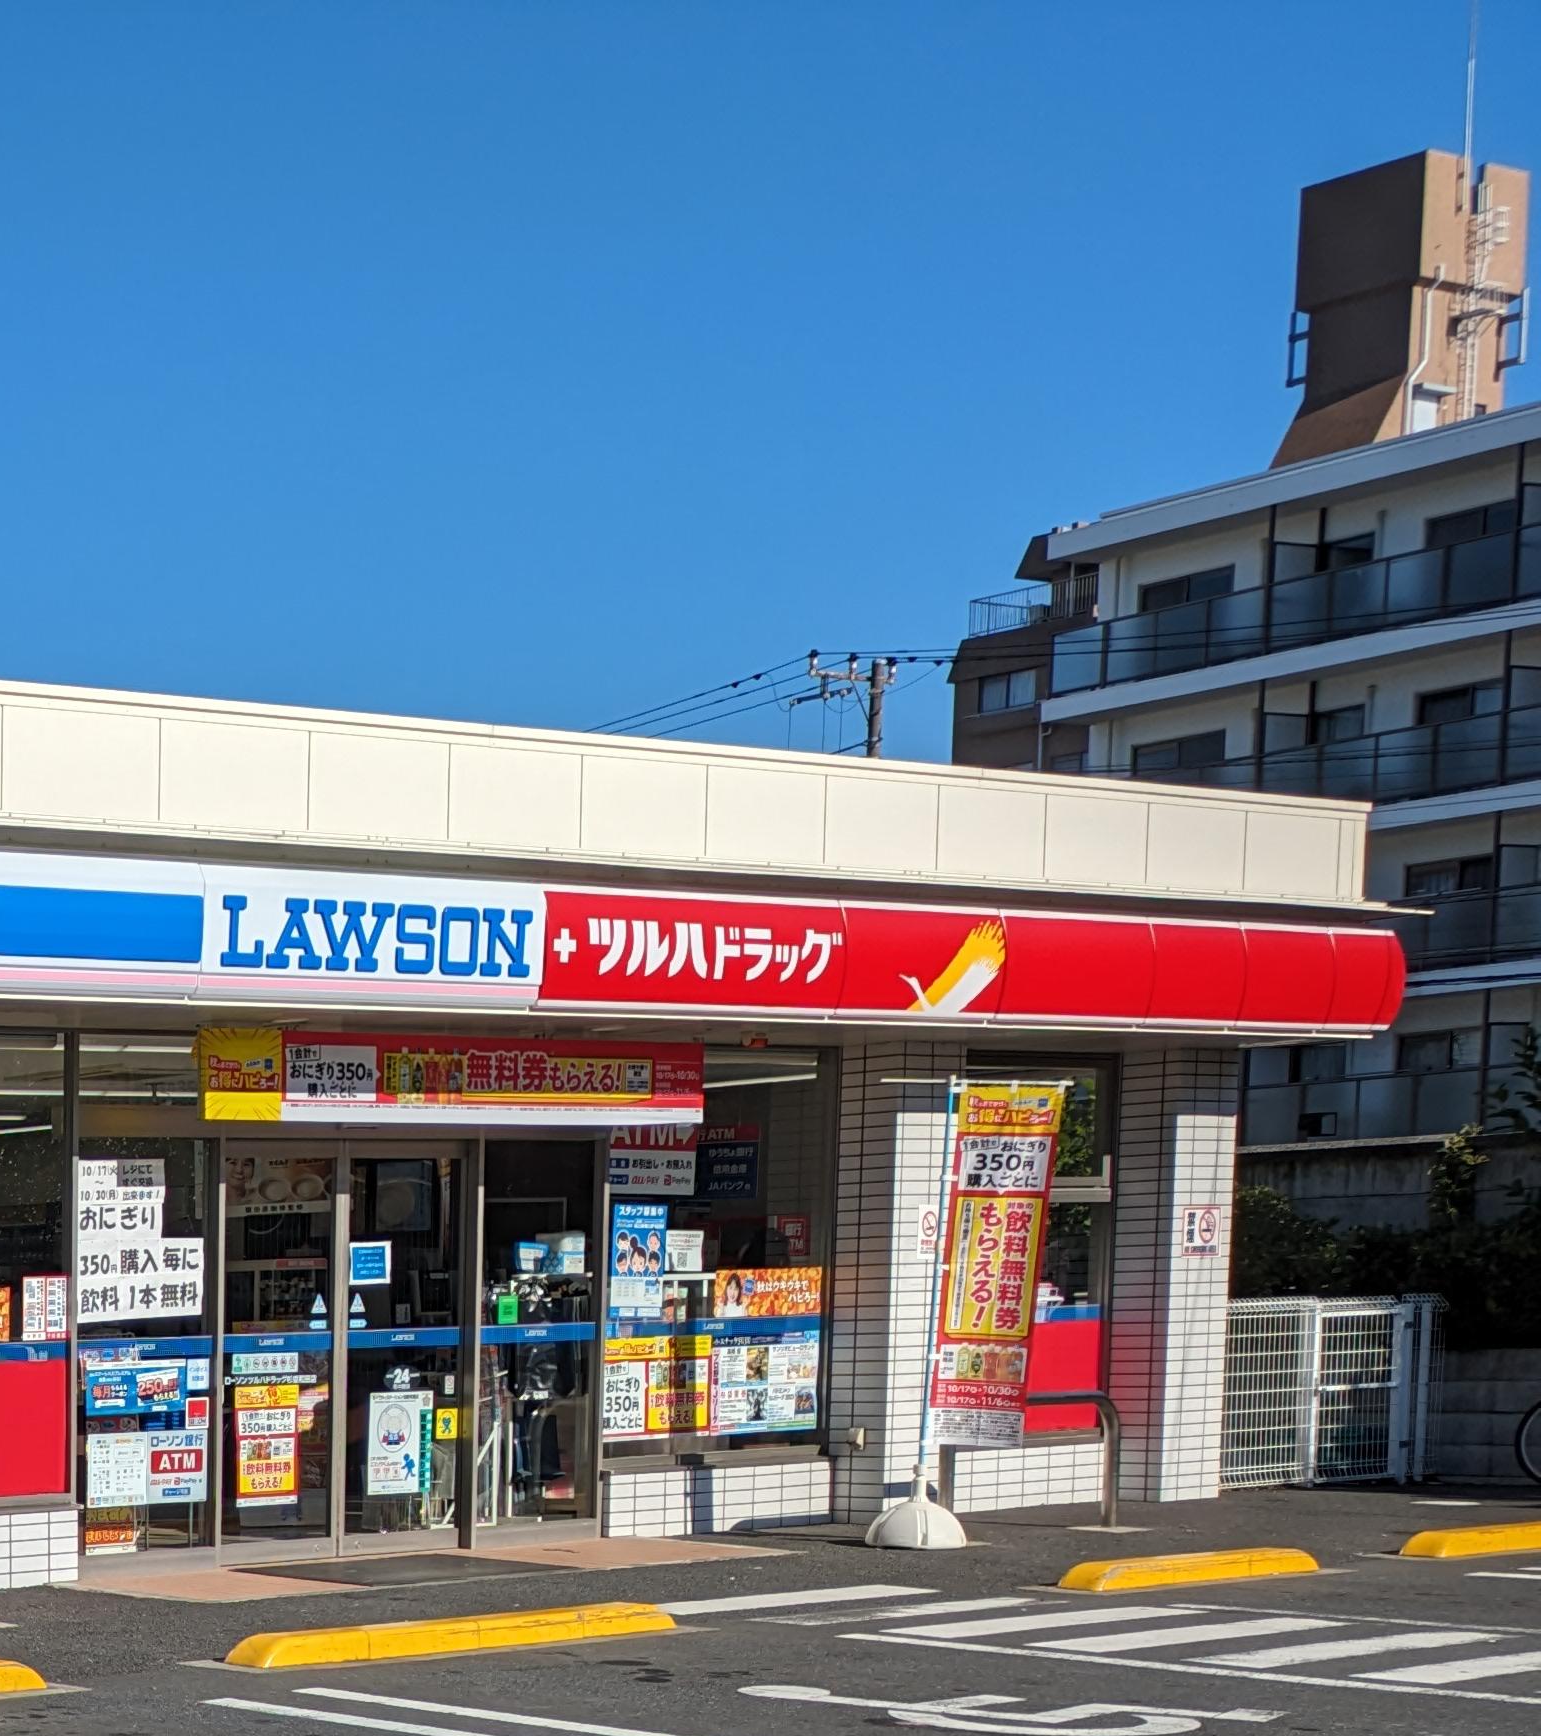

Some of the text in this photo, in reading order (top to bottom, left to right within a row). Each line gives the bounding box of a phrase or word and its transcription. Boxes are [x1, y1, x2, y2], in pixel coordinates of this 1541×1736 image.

[220, 895, 533, 978] LAWSON
[587, 916, 842, 984] ツルハドラッグ
[290, 1061, 373, 1081] おにぎり350円
[307, 1081, 357, 1098] 購入ごとに
[1001, 1141, 1047, 1153] おにぎり
[122, 1164, 153, 1175] レジにて
[973, 1153, 1035, 1171] 350円
[966, 1174, 1038, 1188] 購入ごとに
[79, 1206, 155, 1231] おにぎり
[995, 1211, 1033, 1330] 飲料無料券
[393, 1368, 411, 1384] 24
[606, 1378, 640, 1393] おにぎり
[605, 1396, 639, 1412] 350円
[151, 1434, 203, 1447] ローソン銀行
[159, 1453, 195, 1470] ATM
